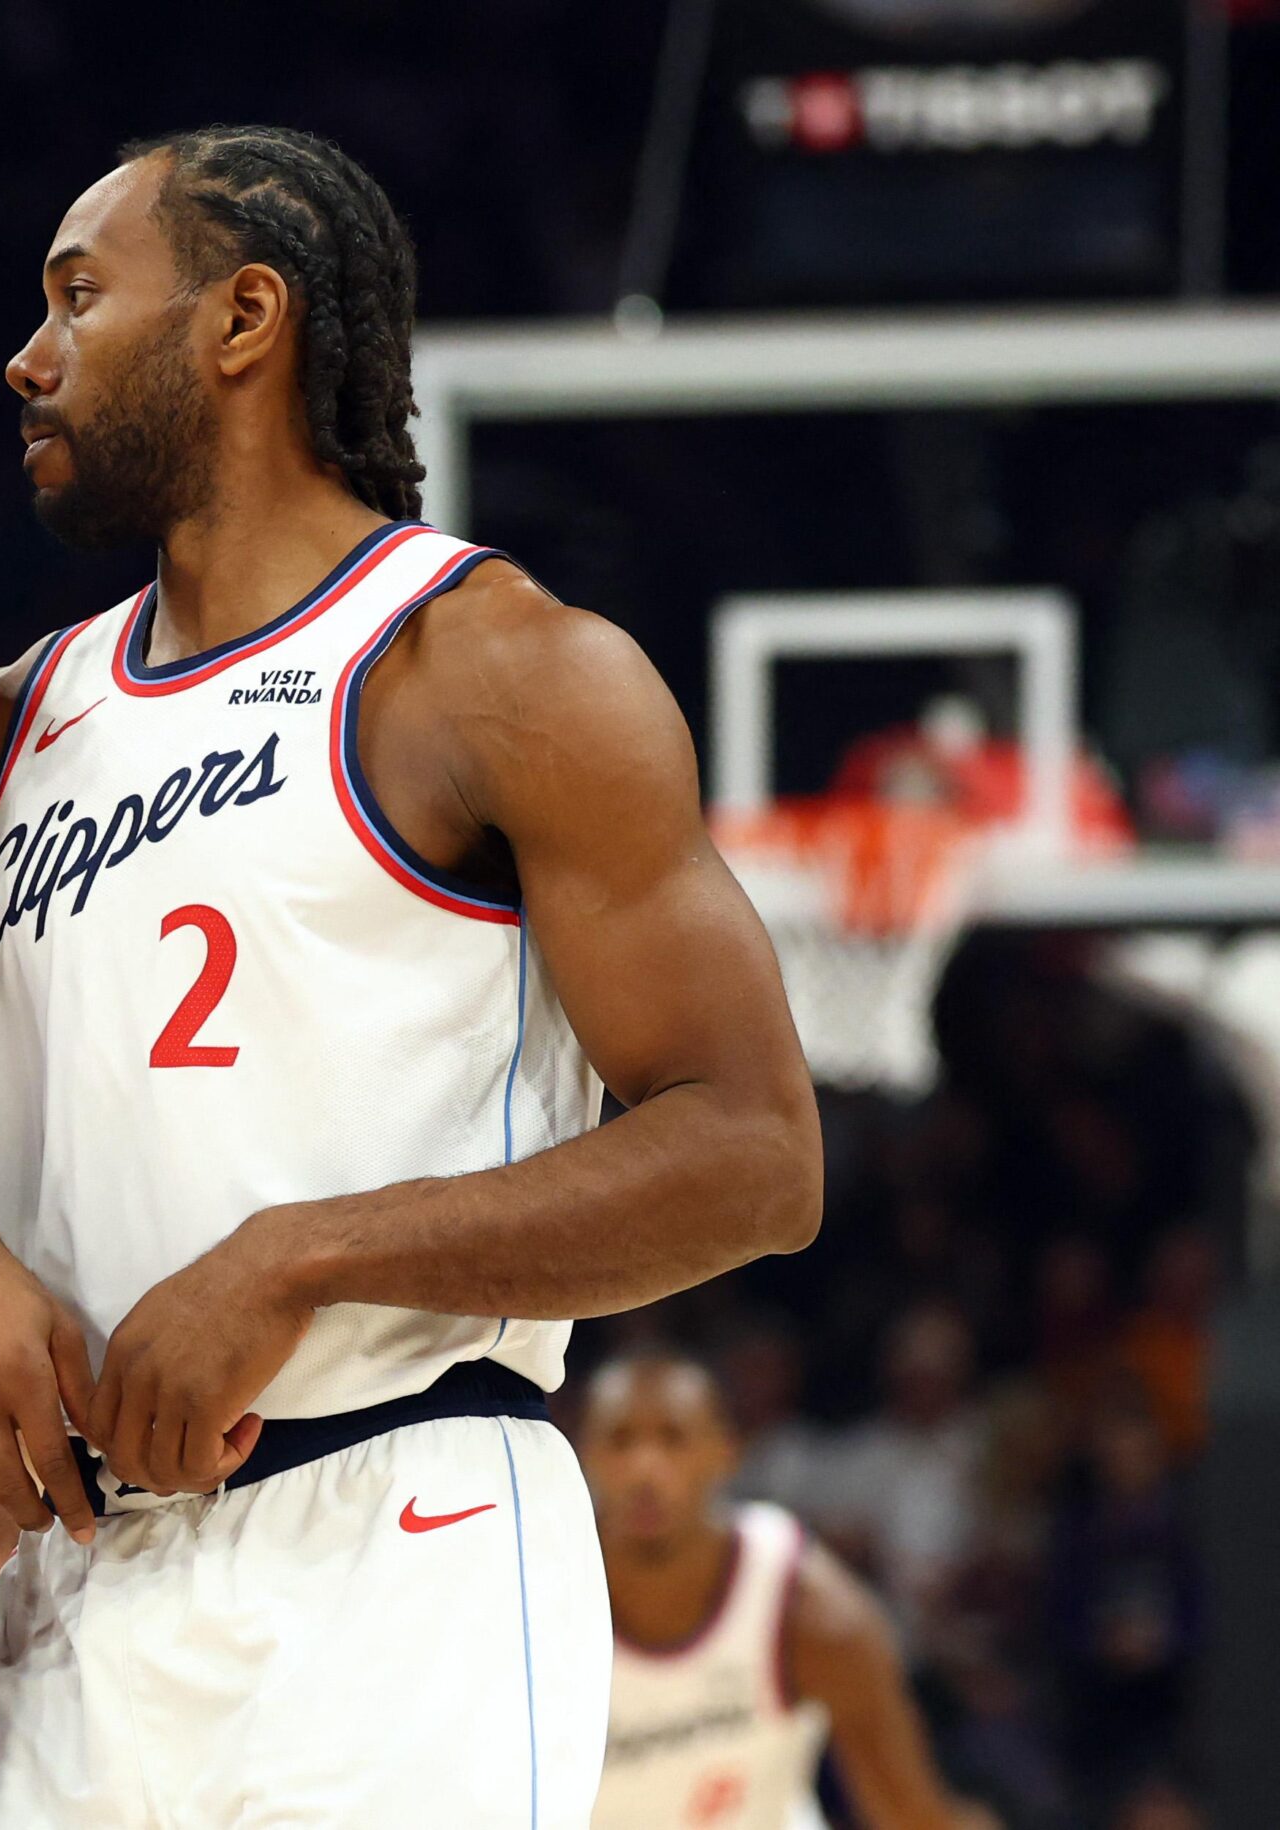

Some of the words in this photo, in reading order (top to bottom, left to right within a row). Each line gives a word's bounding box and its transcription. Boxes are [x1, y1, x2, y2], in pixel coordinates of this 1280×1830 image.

[260, 669, 317, 687] VISIT
[227, 687, 322, 705] RWANDA
[148, 903, 241, 1069] 2
